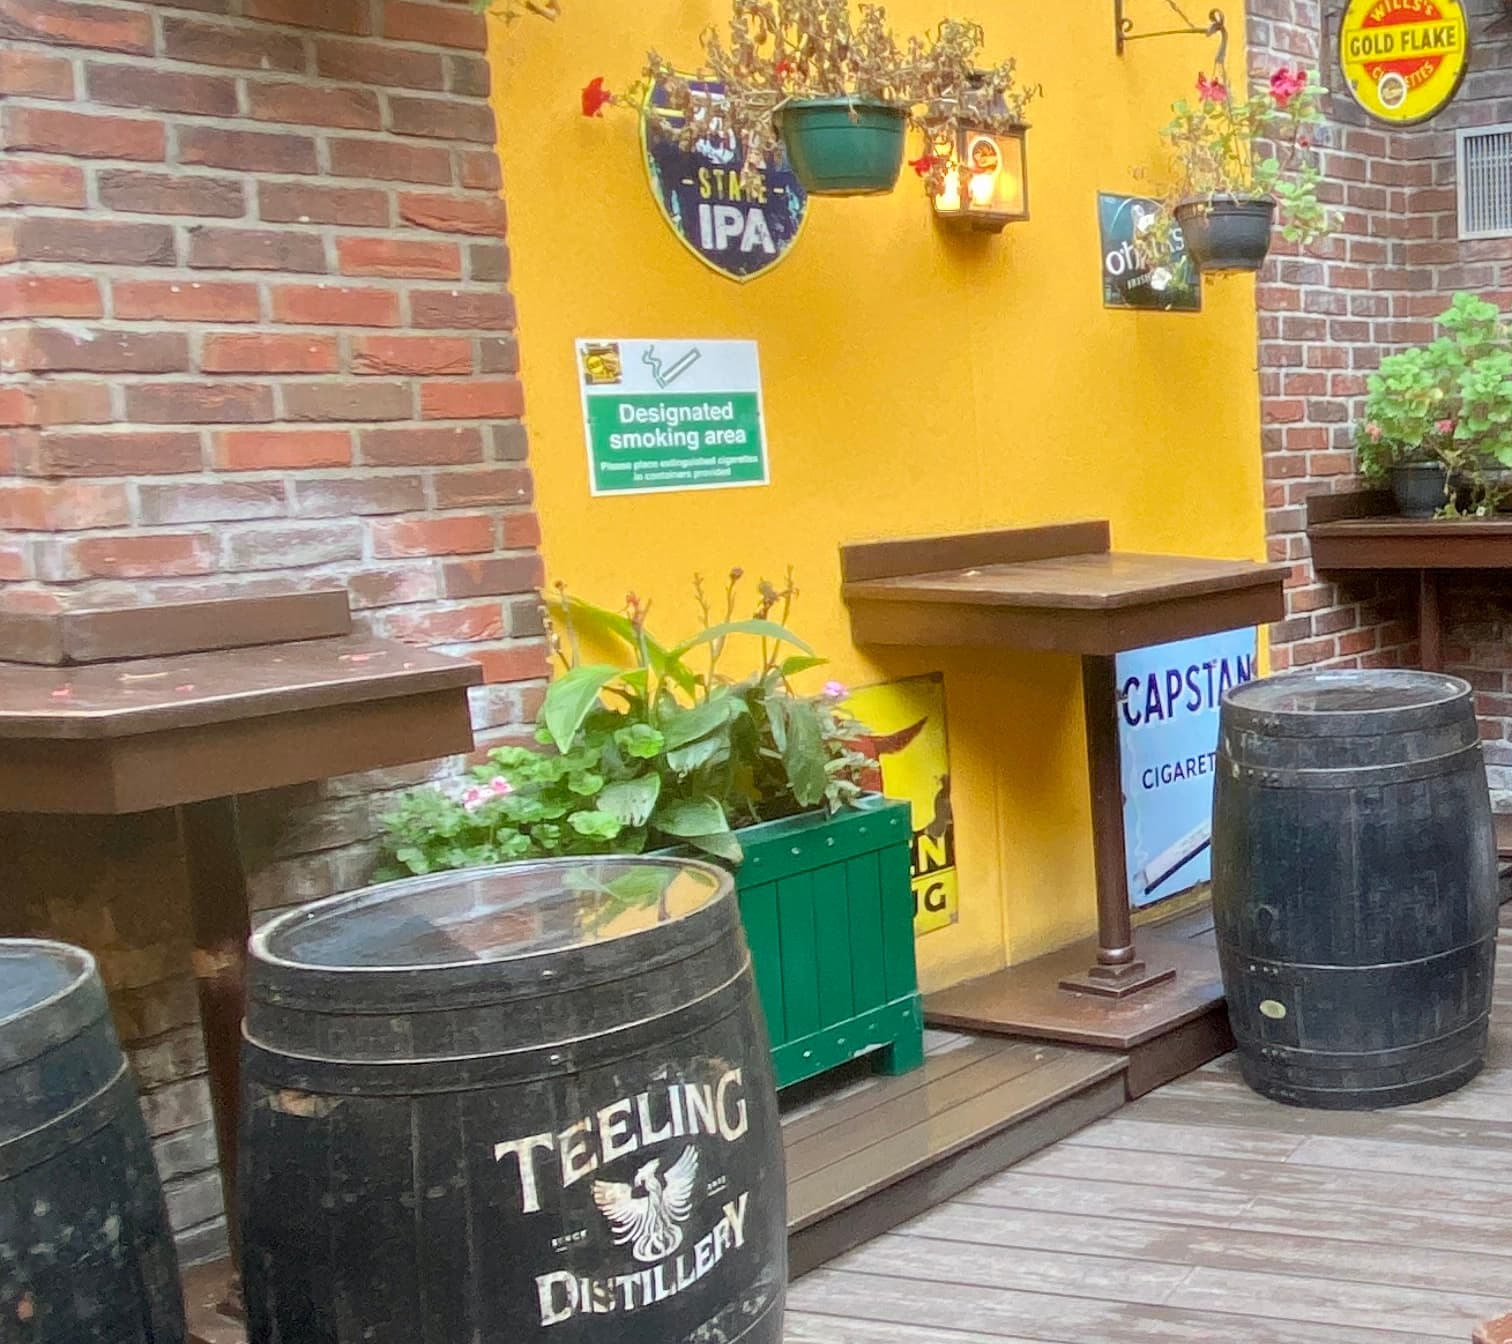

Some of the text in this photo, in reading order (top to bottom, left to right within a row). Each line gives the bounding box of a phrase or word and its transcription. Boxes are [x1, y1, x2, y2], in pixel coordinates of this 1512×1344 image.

[1350, 24, 1457, 57] GOLD FLAKE
[1371, 60, 1435, 90] CIETTES
[698, 203, 777, 255] IPA
[618, 401, 734, 426] Designated
[609, 428, 748, 451] smoking area
[1122, 654, 1252, 727] CAPSTAN
[1142, 752, 1216, 790] CIGARET
[494, 1068, 748, 1214] TEELING
[535, 1191, 750, 1328] DISTILLERY
